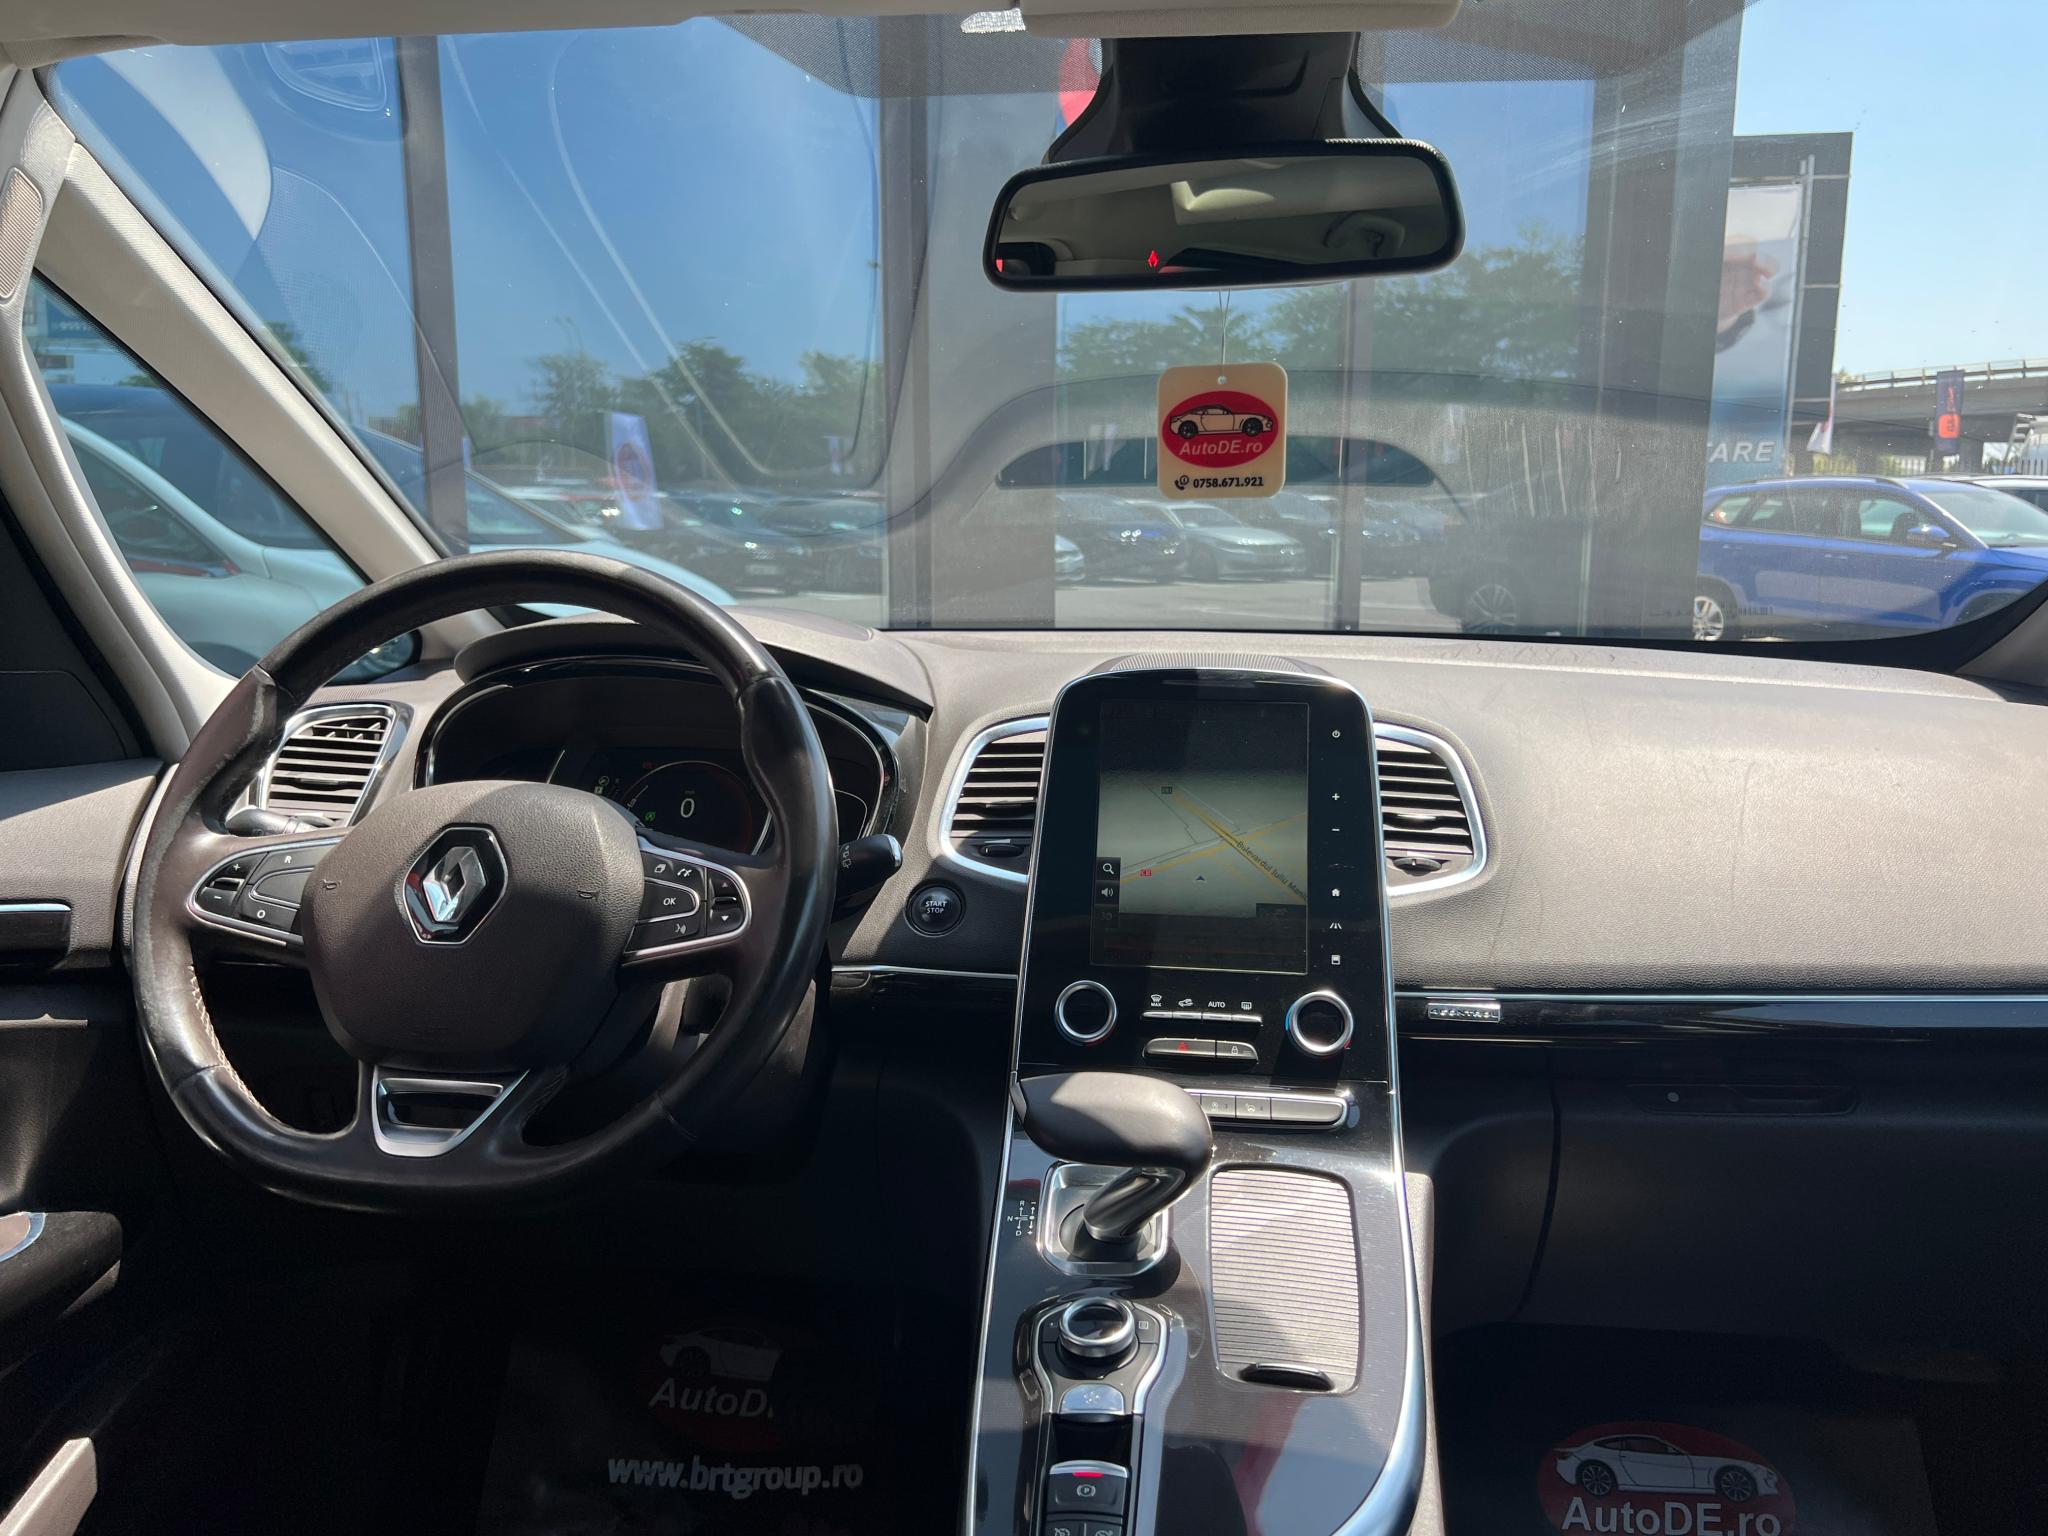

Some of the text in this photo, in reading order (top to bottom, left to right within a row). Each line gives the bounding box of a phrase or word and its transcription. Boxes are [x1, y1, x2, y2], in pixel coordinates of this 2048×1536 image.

[1179, 439, 1263, 456] AutoDE.ro
[1707, 440, 1775, 463] ARE
[1193, 476, 1264, 489] 0758.671.921
[680, 798, 695, 818] 0
[284, 856, 292, 864] R
[663, 897, 677, 906] OK
[608, 1456, 864, 1500] www.brtgroup.ro
[1561, 1496, 1782, 1536] AutoDE.ro
